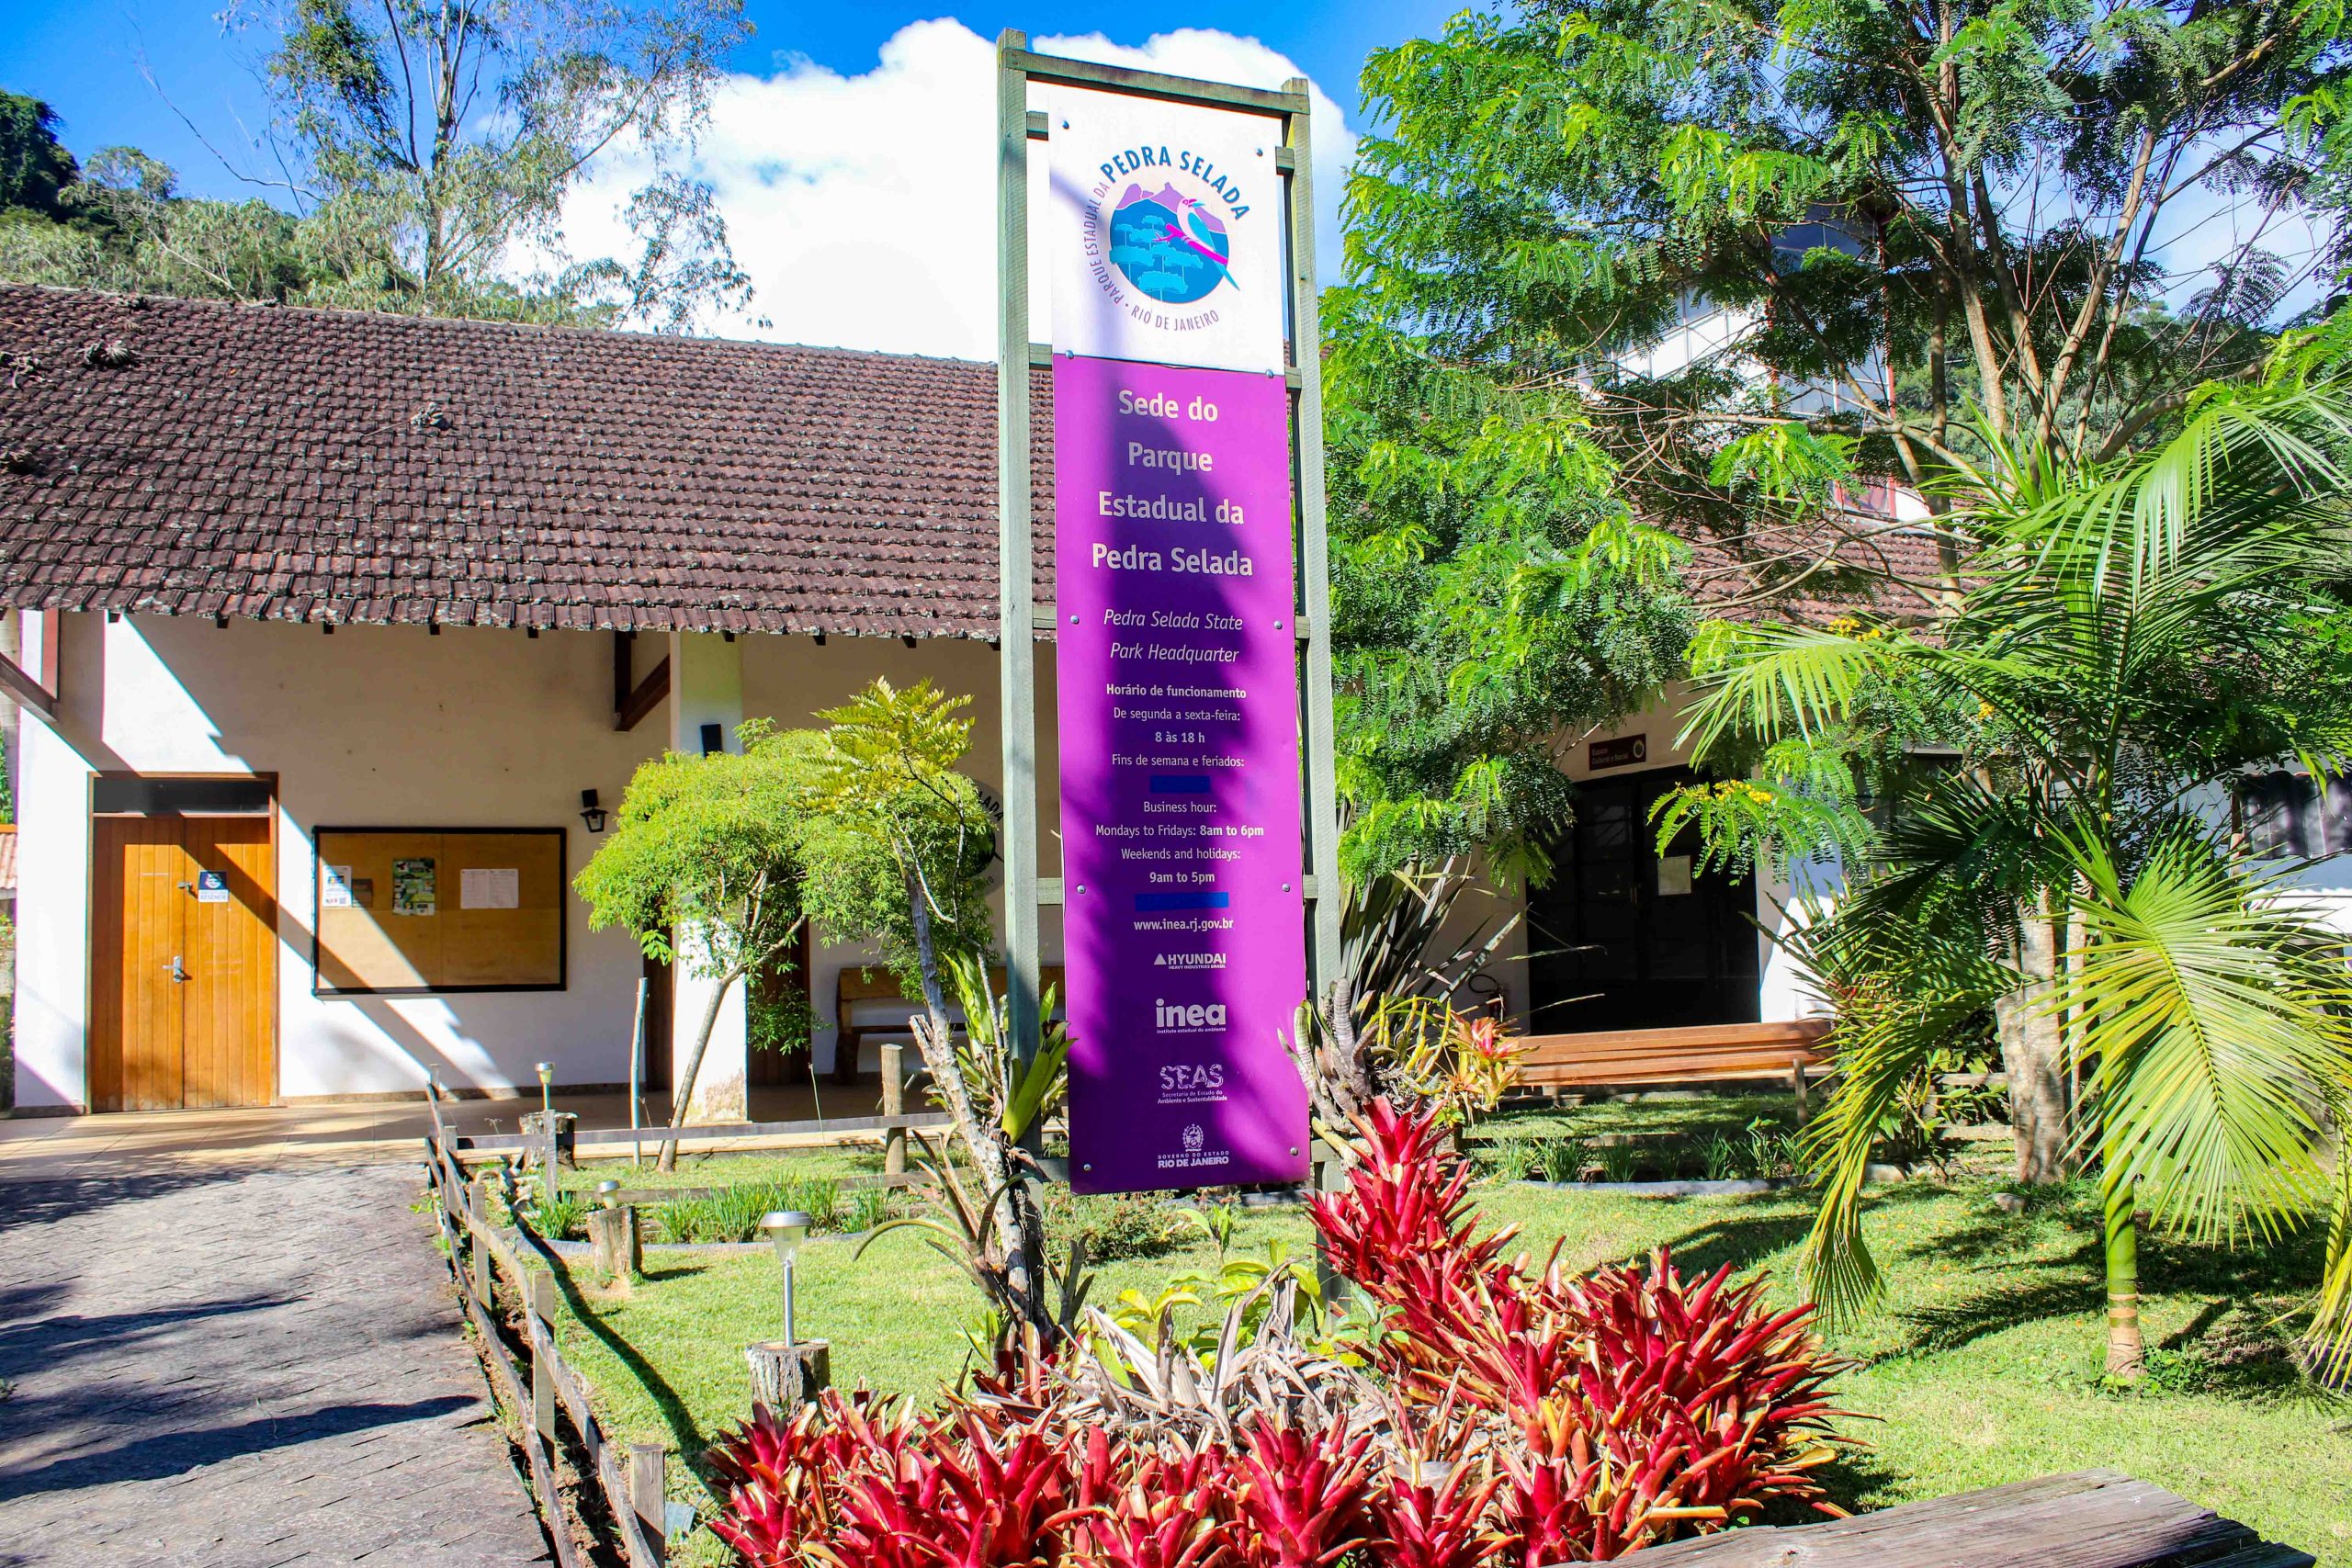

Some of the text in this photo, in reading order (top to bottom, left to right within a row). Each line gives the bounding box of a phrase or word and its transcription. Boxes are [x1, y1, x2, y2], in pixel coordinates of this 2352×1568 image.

[1100, 146, 1250, 220] PEDRA SELADA
[1083, 182, 1125, 304] PARQUE ESTADUAL DA
[1131, 305, 1219, 331] RIO DE JANEIRO
[1118, 389, 1218, 422] Sede do
[1128, 442, 1213, 475] Parque
[1099, 491, 1245, 525] Estadual da
[1092, 543, 1253, 576] Pedra Selada
[1103, 609, 1243, 630] Pedra Selada State
[1110, 642, 1239, 665] Park Headquarter
[1106, 683, 1247, 699] Horário de funcionamento
[1114, 707, 1241, 721] De segunda a sexta-feira:
[1155, 730, 1205, 743] 8 às 18 h
[1112, 754, 1245, 767] Fins de semana e feriados:
[1144, 801, 1217, 813] Business hour:
[1096, 825, 1264, 839] Mondays to Fridays: 8am to 6pm
[1121, 848, 1240, 862] Weekends and holidays:
[1149, 872, 1216, 885] 9am to 5pm
[1134, 917, 1234, 932] www.inea.rj.gov.br
[1168, 953, 1227, 965] HYUNDAI
[1156, 998, 1227, 1027] inea
[1159, 1064, 1224, 1090] SEAS
[1158, 1156, 1229, 1168] RIO DE JANEIRO
